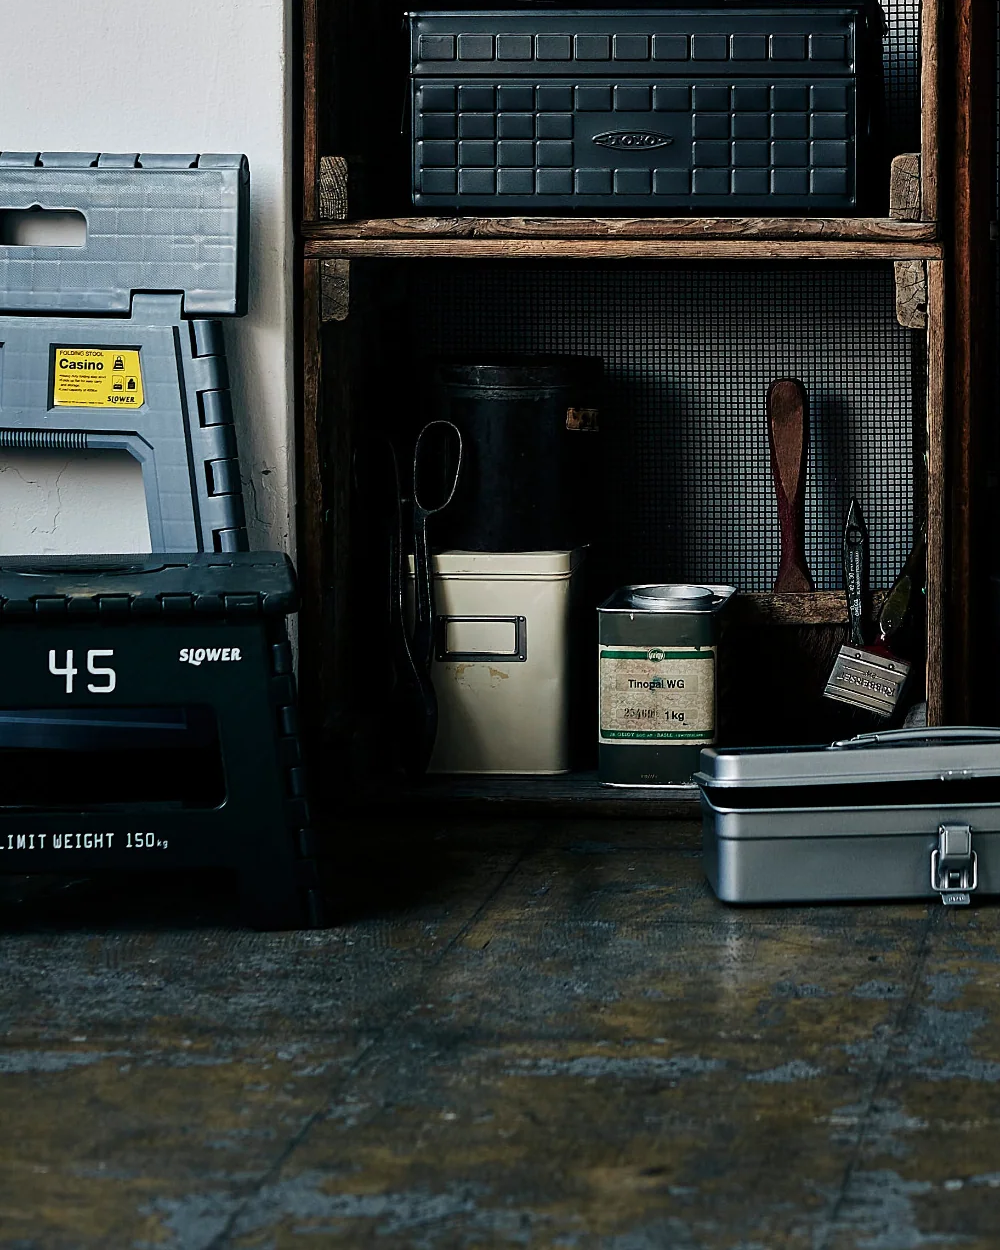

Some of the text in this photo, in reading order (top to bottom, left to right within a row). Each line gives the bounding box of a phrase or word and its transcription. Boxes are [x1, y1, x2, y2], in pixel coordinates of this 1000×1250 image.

[59, 358, 104, 370] Casino
[107, 396, 135, 404] SLOWER
[179, 648, 242, 666] SLOWER
[49, 650, 116, 693] 45
[628, 679, 685, 691] Tinopal WG
[53, 833, 114, 849] WEIGHT
